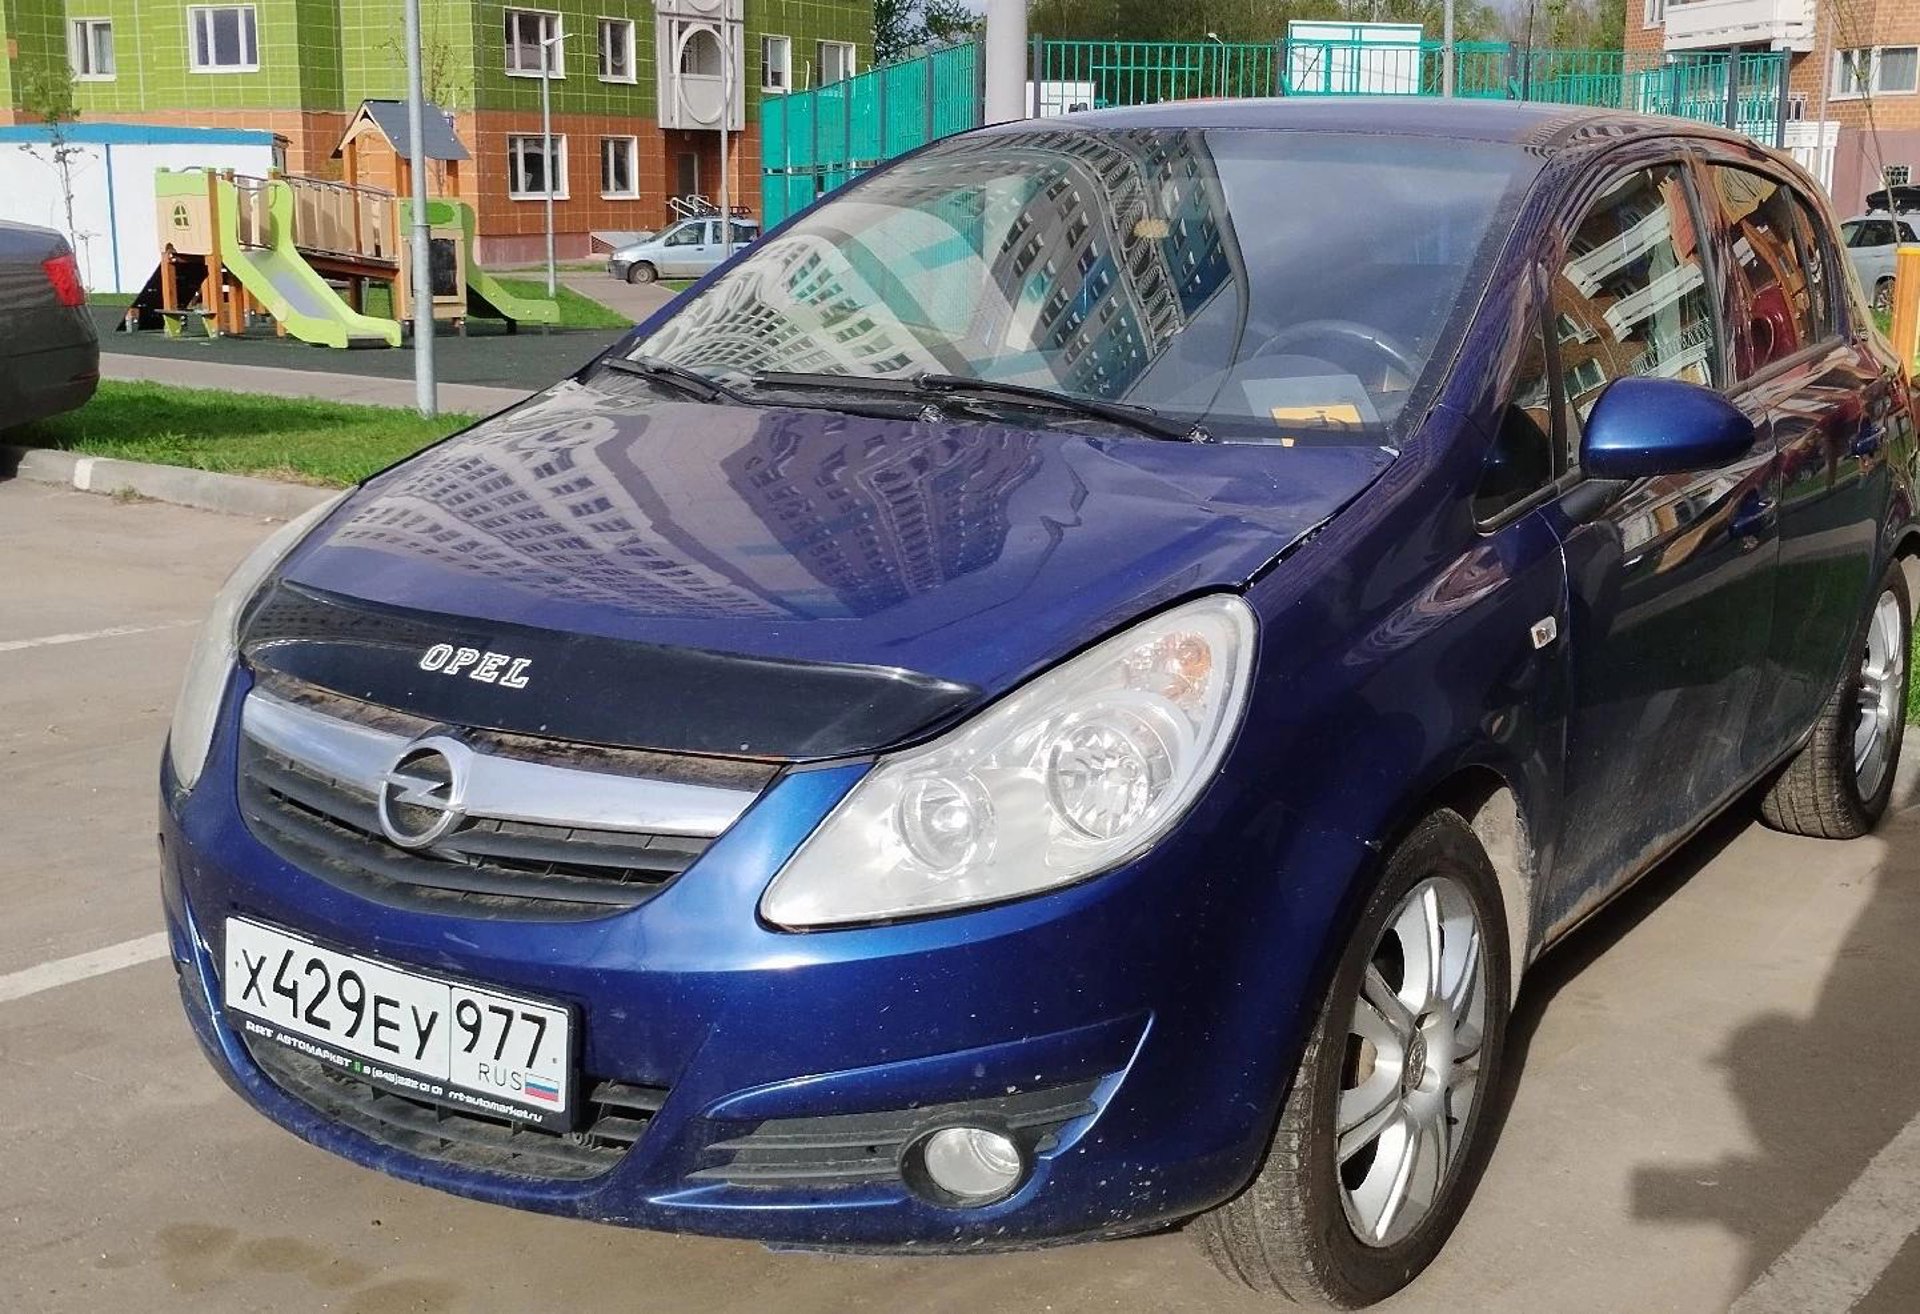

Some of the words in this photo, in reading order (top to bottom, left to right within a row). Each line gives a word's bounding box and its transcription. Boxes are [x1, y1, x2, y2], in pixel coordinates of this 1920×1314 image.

[419, 643, 532, 689] OPEL
[455, 998, 548, 1070] 977
[478, 1062, 523, 1091] RUS
